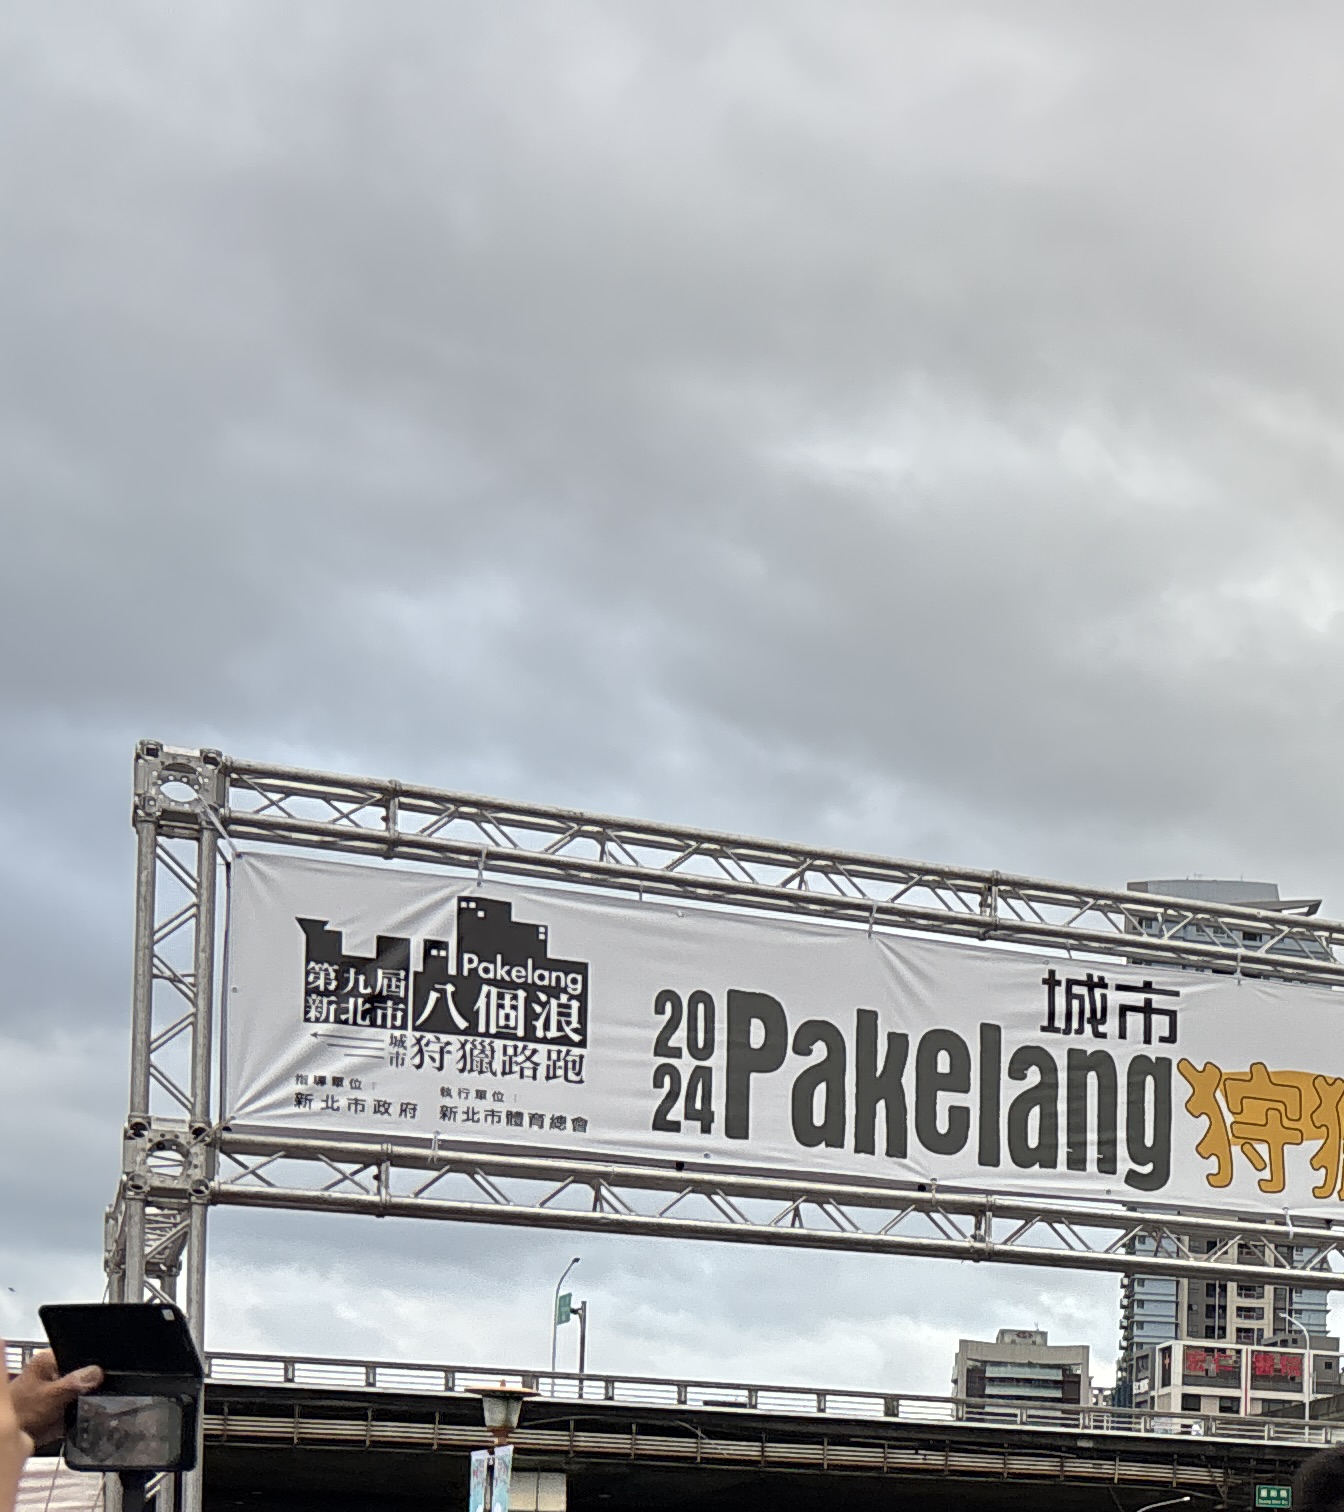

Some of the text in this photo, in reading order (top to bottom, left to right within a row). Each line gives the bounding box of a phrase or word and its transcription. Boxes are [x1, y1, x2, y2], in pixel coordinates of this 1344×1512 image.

[306, 961, 406, 998] 第九屆
[463, 953, 583, 994] Pakelang
[305, 996, 406, 1029] 新北市
[415, 982, 583, 1043] 八個浪
[1040, 969, 1181, 1045] 城市
[388, 1032, 407, 1068] 城市
[411, 1033, 585, 1084] 狩獵路跑
[293, 1092, 418, 1120] 新北市政府
[725, 988, 1173, 1192] Pakelang
[439, 1105, 588, 1134] 新北市體育總會
